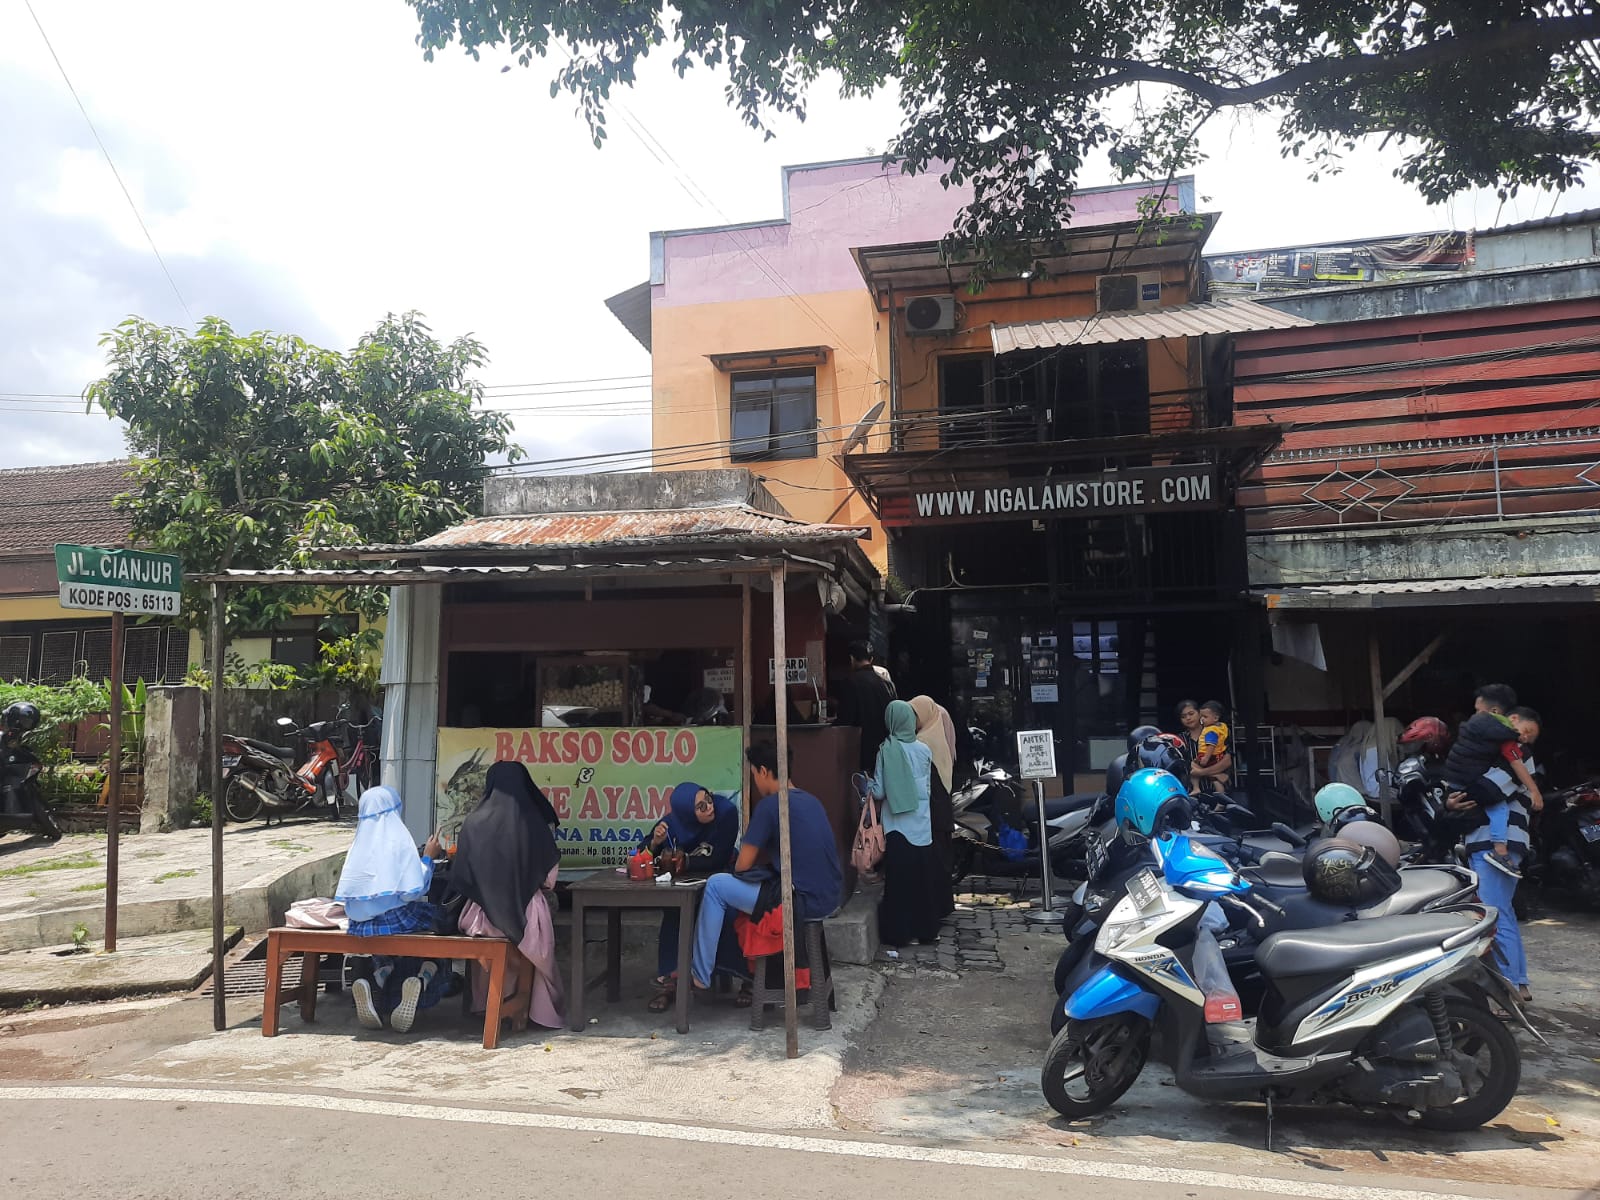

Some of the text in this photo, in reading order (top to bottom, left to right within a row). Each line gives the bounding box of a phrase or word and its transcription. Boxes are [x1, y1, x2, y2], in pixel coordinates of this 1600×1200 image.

[67, 551, 172, 585] JL. CIANJUR
[69, 588, 104, 606] KODE
[107, 591, 131, 608] POS
[142, 594, 173, 612] 65113
[494, 730, 697, 764] BAKSO SOLO
[1023, 733, 1048, 744] ANTRI
[578, 767, 595, 784] &
[578, 786, 675, 820] AYAM
[589, 827, 644, 841] RASA
[601, 846, 615, 856] 081
[1134, 952, 1165, 962] HONDA
